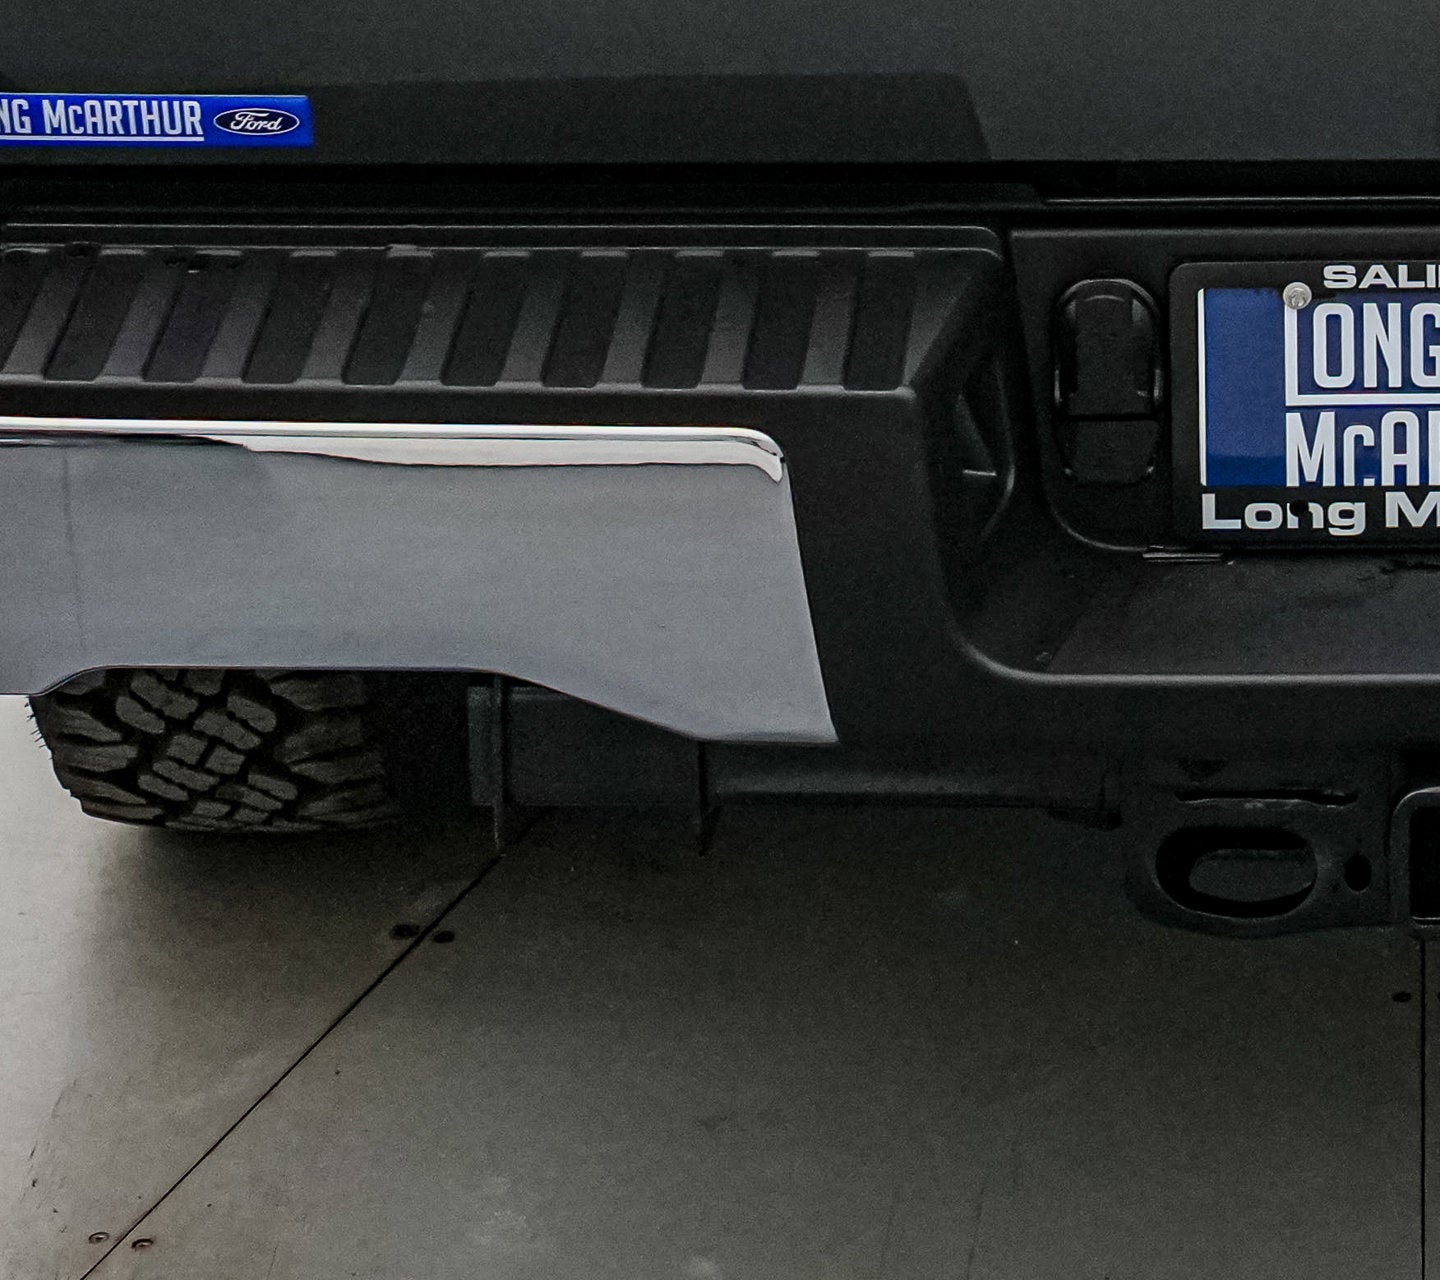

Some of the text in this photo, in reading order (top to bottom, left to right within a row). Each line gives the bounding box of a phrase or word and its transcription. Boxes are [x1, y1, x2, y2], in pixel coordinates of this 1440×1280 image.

[42, 98, 204, 136] McARTHUR
[230, 108, 282, 132] Ford
[1201, 493, 1366, 536] Long
